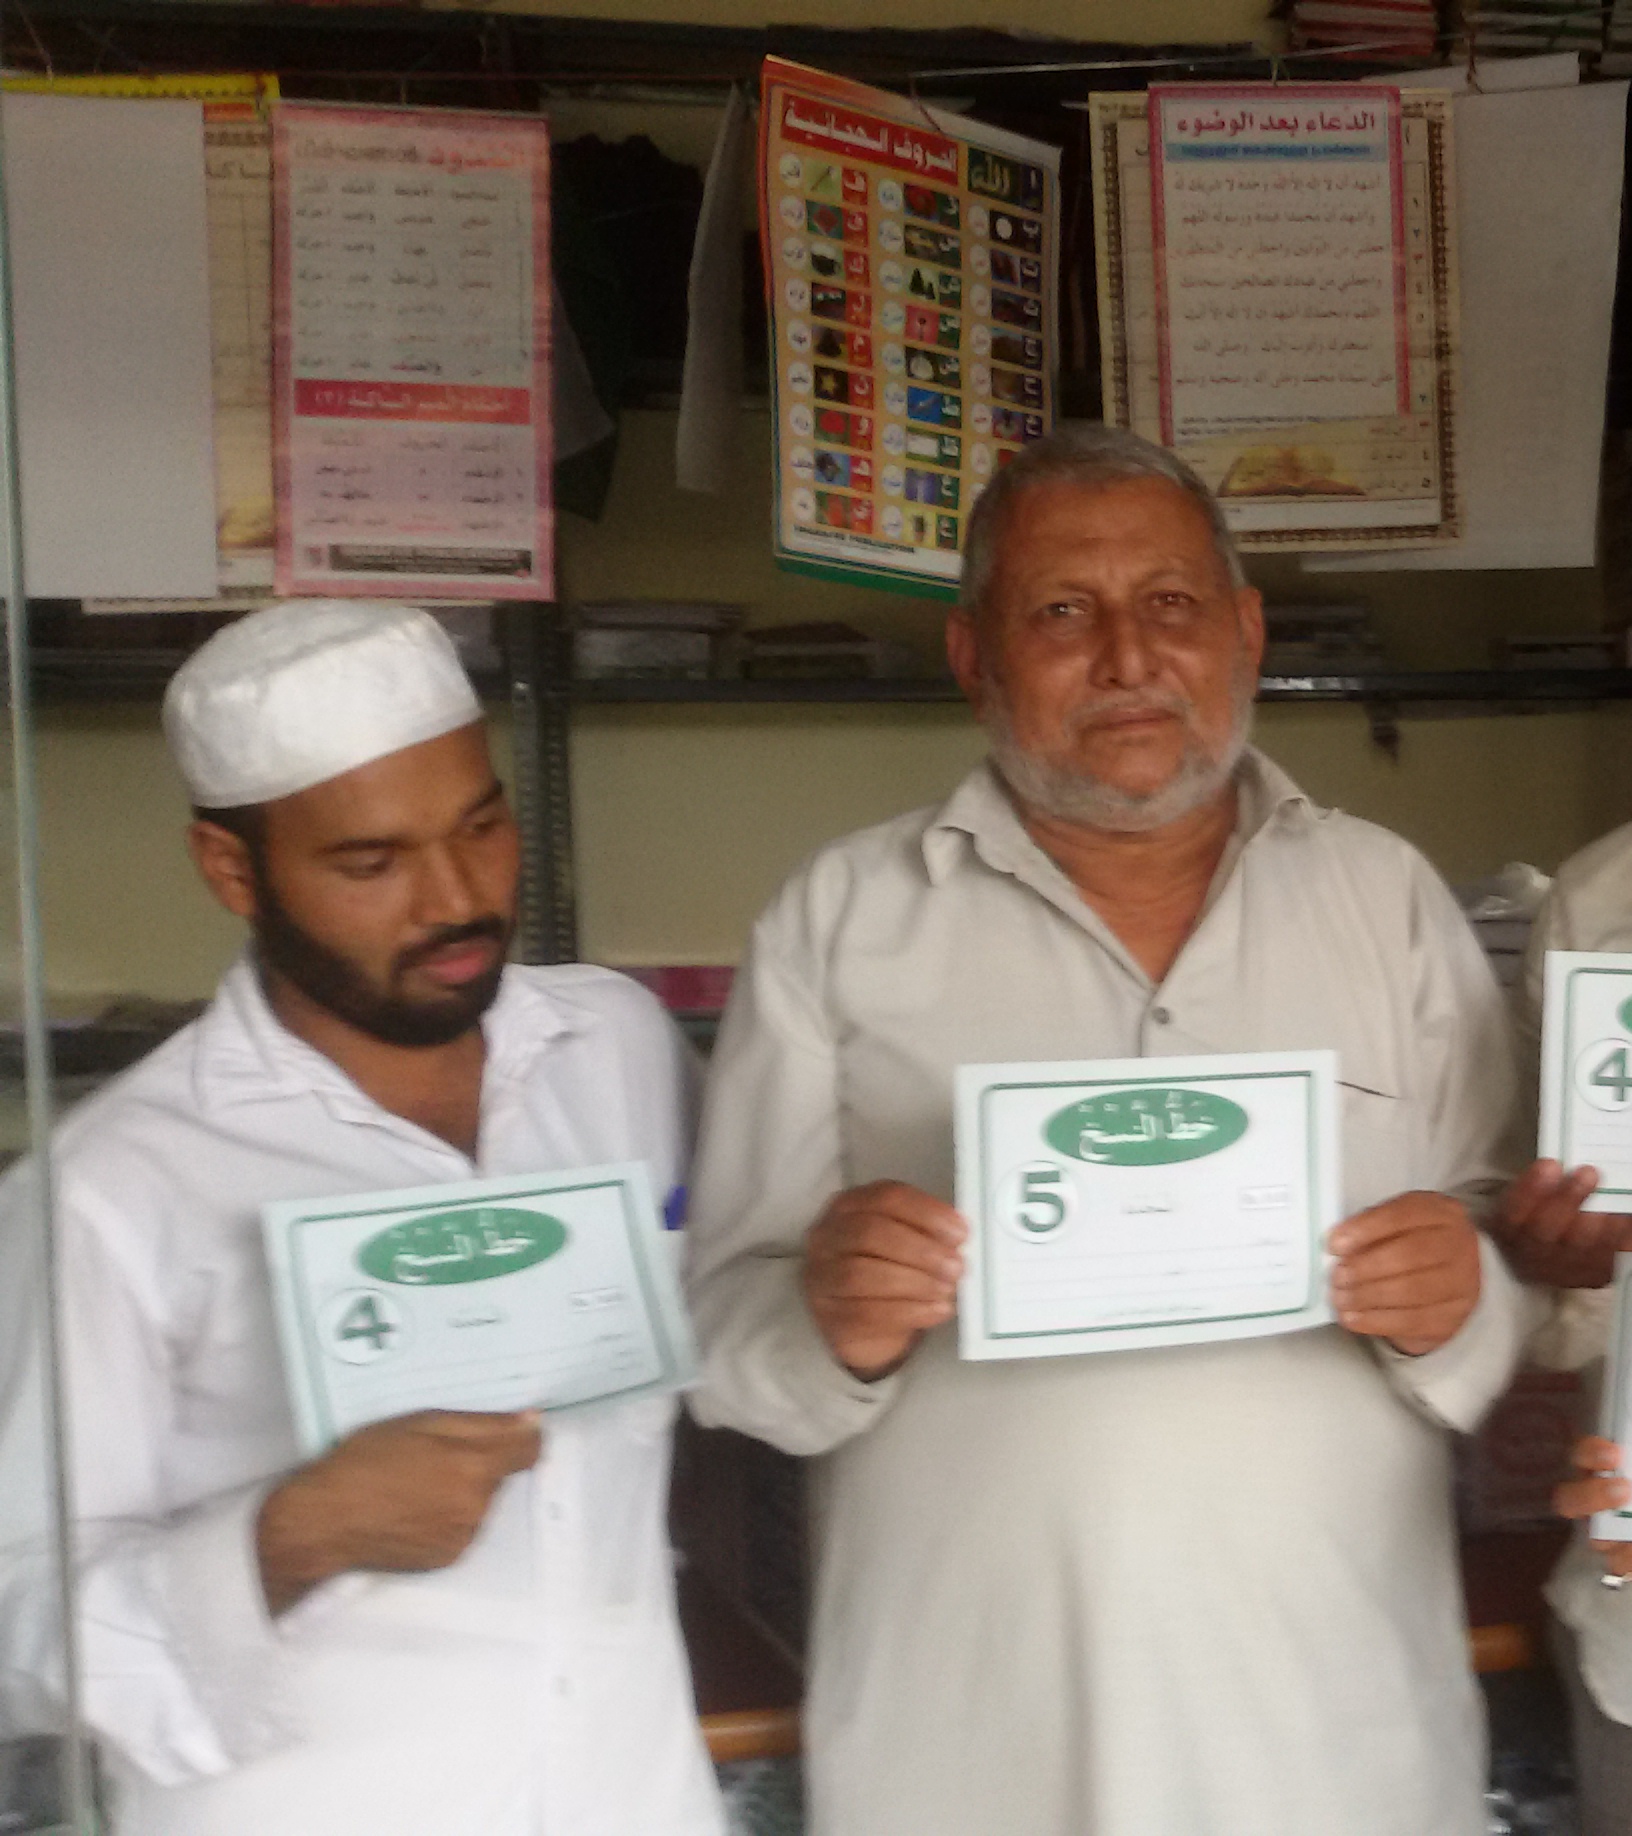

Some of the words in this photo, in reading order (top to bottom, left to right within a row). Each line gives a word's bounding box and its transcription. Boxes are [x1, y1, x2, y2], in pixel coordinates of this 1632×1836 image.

[1177, 108, 1254, 138] الوضوء
[1259, 113, 1299, 137] بعد
[1305, 108, 1375, 133] الدعاء
[1017, 1170, 1066, 1233] 5
[337, 1294, 396, 1351] 4
